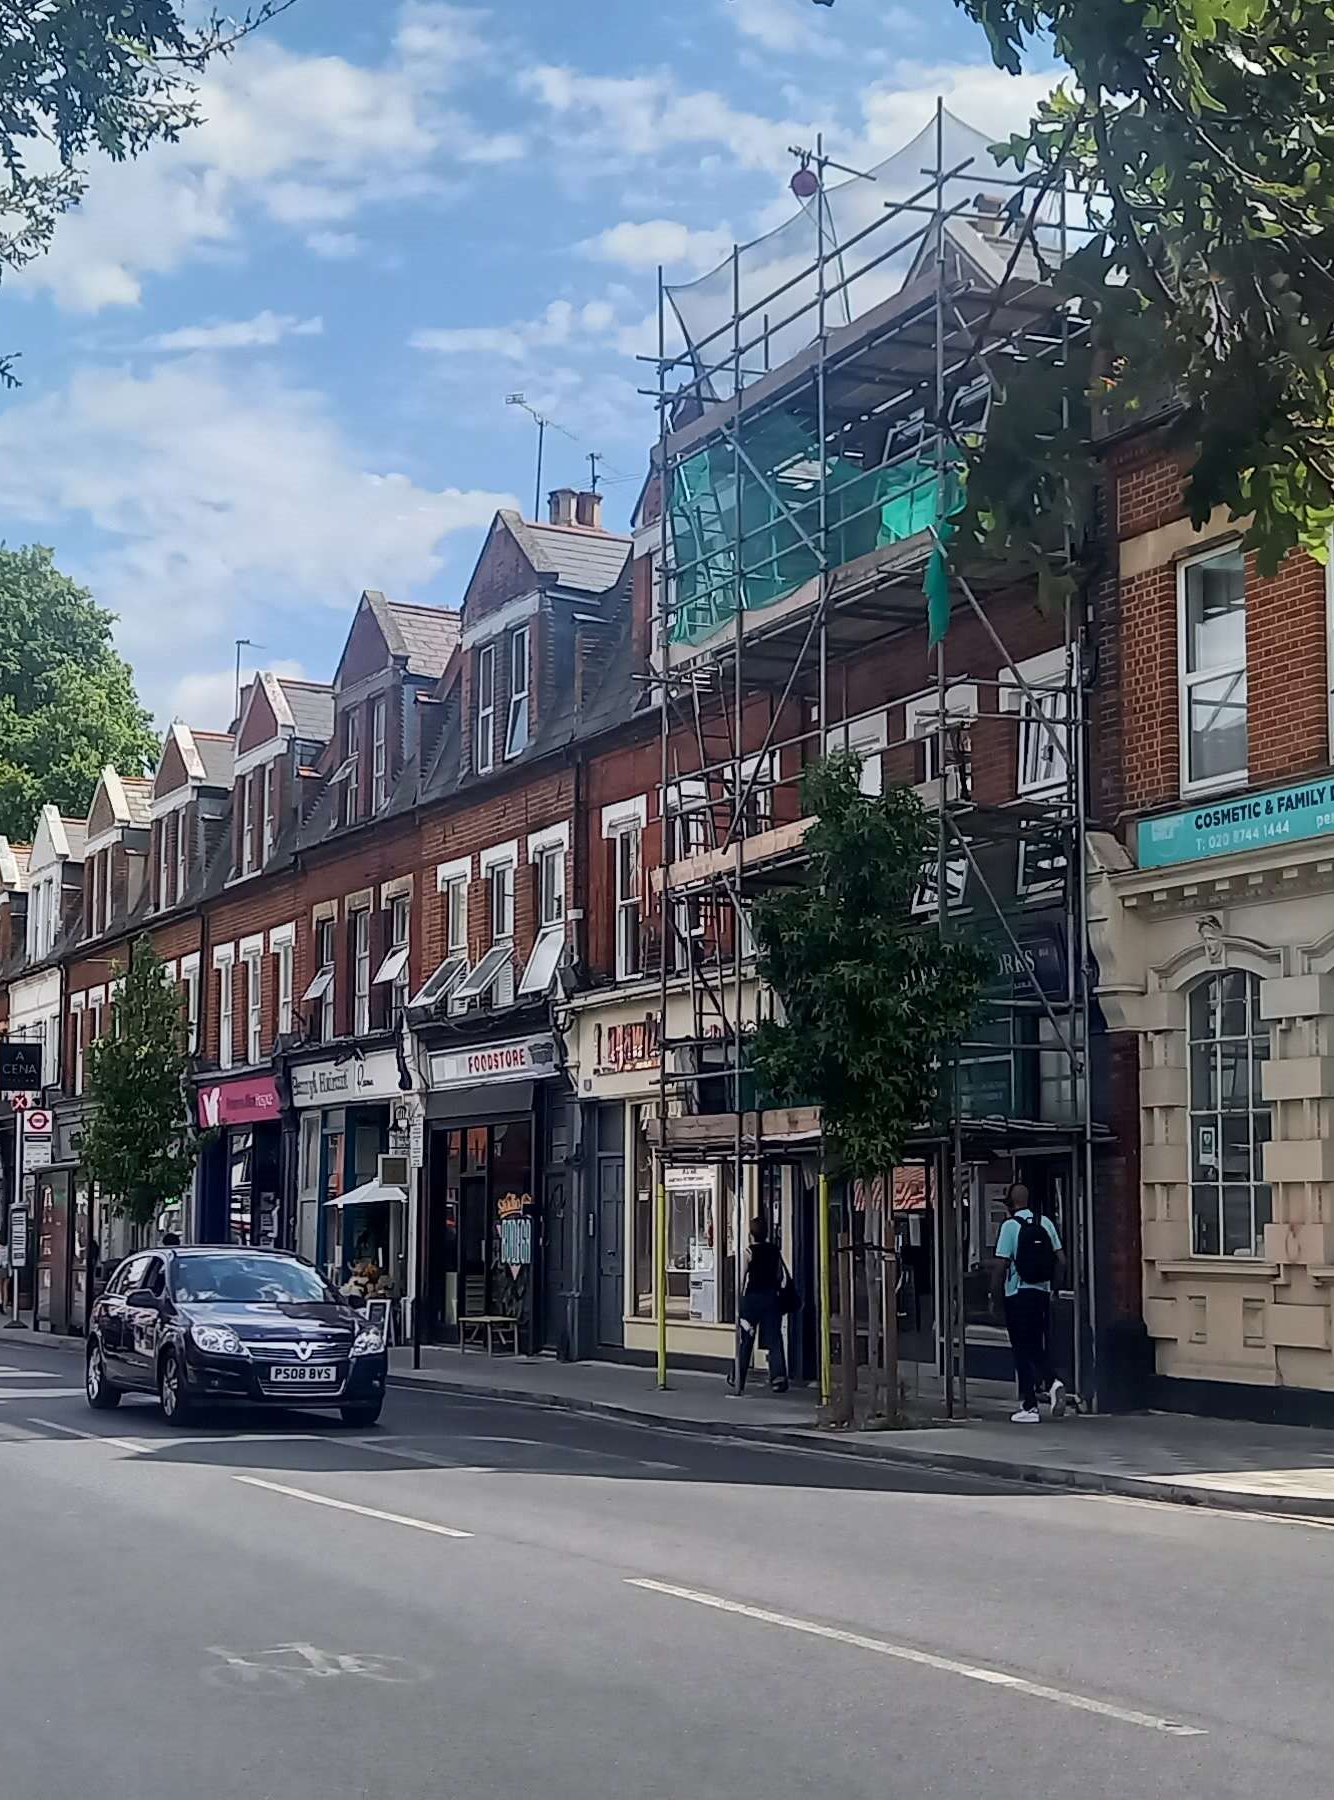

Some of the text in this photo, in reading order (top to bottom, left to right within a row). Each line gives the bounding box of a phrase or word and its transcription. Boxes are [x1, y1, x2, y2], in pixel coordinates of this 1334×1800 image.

[1194, 802, 1262, 830] COSMETIC
[1264, 798, 1274, 815] &
[1277, 787, 1327, 814] FAMILY
[1208, 832, 1229, 849] 020
[1263, 820, 1290, 838] 1444
[15, 1051, 25, 1061] A
[468, 1048, 526, 1074] FOODSTORE
[2, 1064, 38, 1075] CENA
[275, 1368, 306, 1379] PS08
